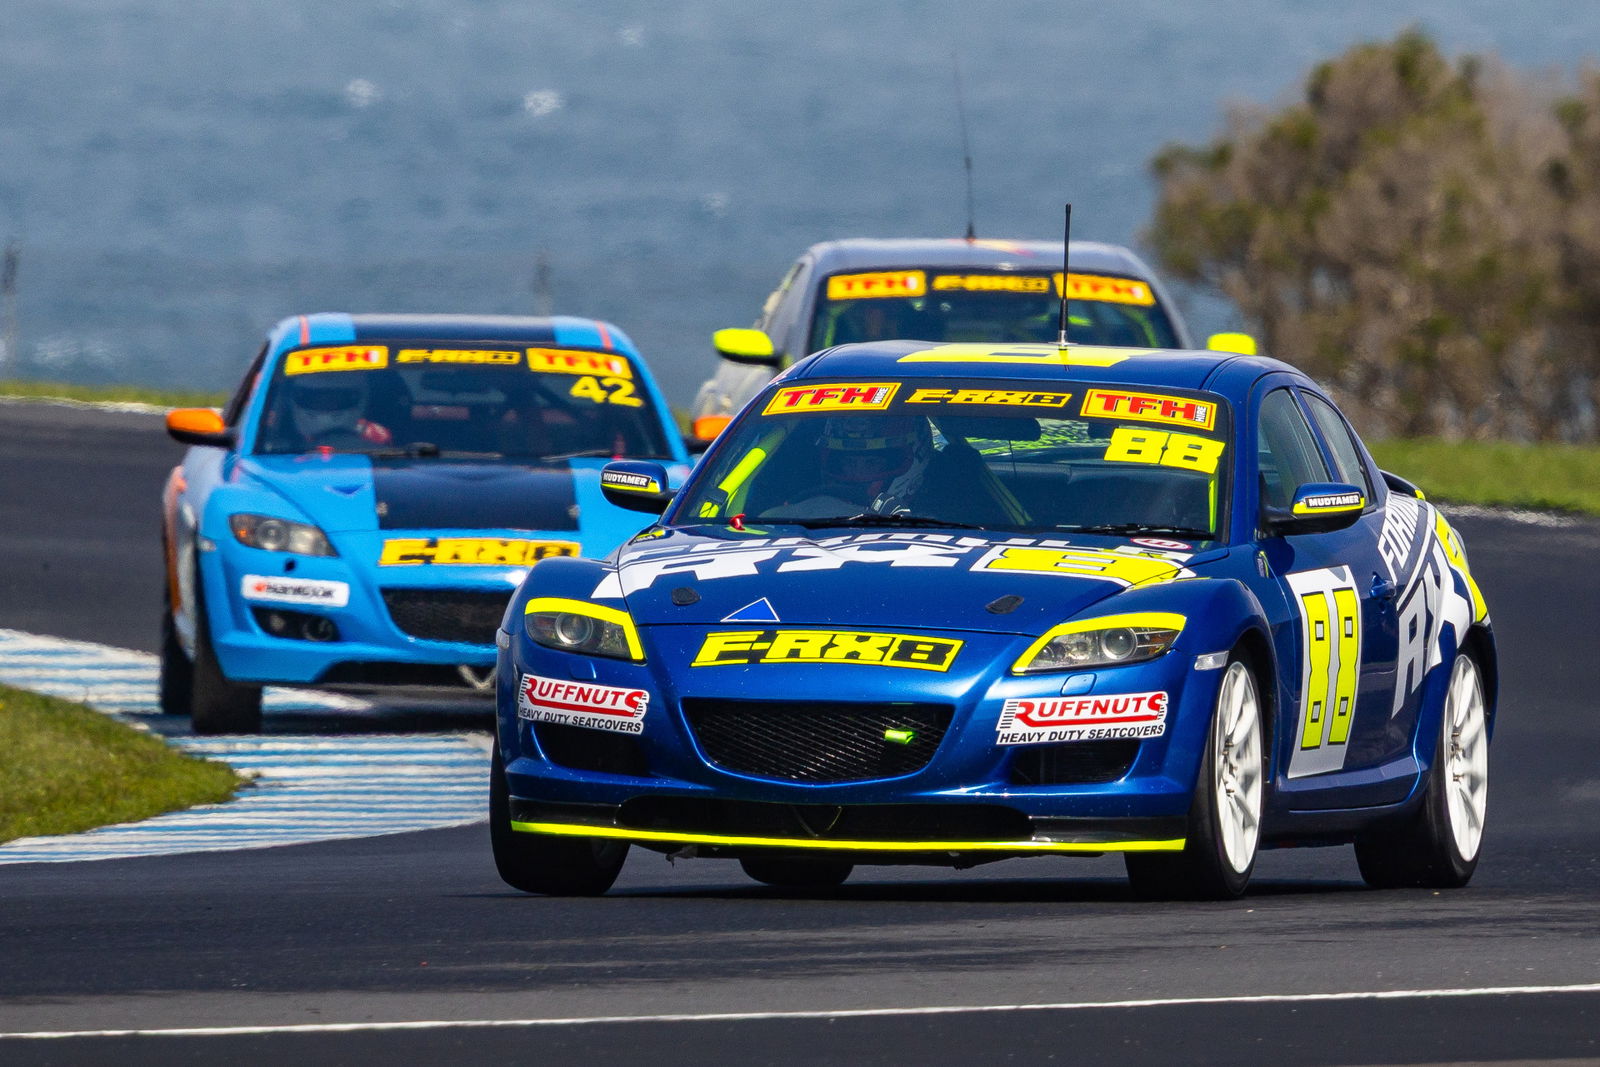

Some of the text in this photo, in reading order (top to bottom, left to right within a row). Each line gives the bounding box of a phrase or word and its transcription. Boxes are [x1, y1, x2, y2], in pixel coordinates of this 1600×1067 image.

[299, 351, 371, 367] TFH
[570, 375, 643, 407] 42
[784, 387, 879, 407] TFH
[904, 389, 1073, 408] F-RX8
[1096, 393, 1208, 423] TFH HIRE
[1103, 427, 1226, 474] 88
[603, 472, 648, 486] MUDTAMER
[1308, 494, 1360, 507] MUDTAMER
[591, 543, 1197, 598] RX8
[690, 630, 965, 673] F-RX8
[1301, 586, 1358, 750] 88
[525, 677, 645, 716] RUFFNUTS
[1015, 692, 1165, 727] RUFFNUTS
[519, 707, 642, 733] HEAVY DUTY SEATCOVERS
[1000, 724, 1164, 744] HEAVY DUTY SEATCOVERS
